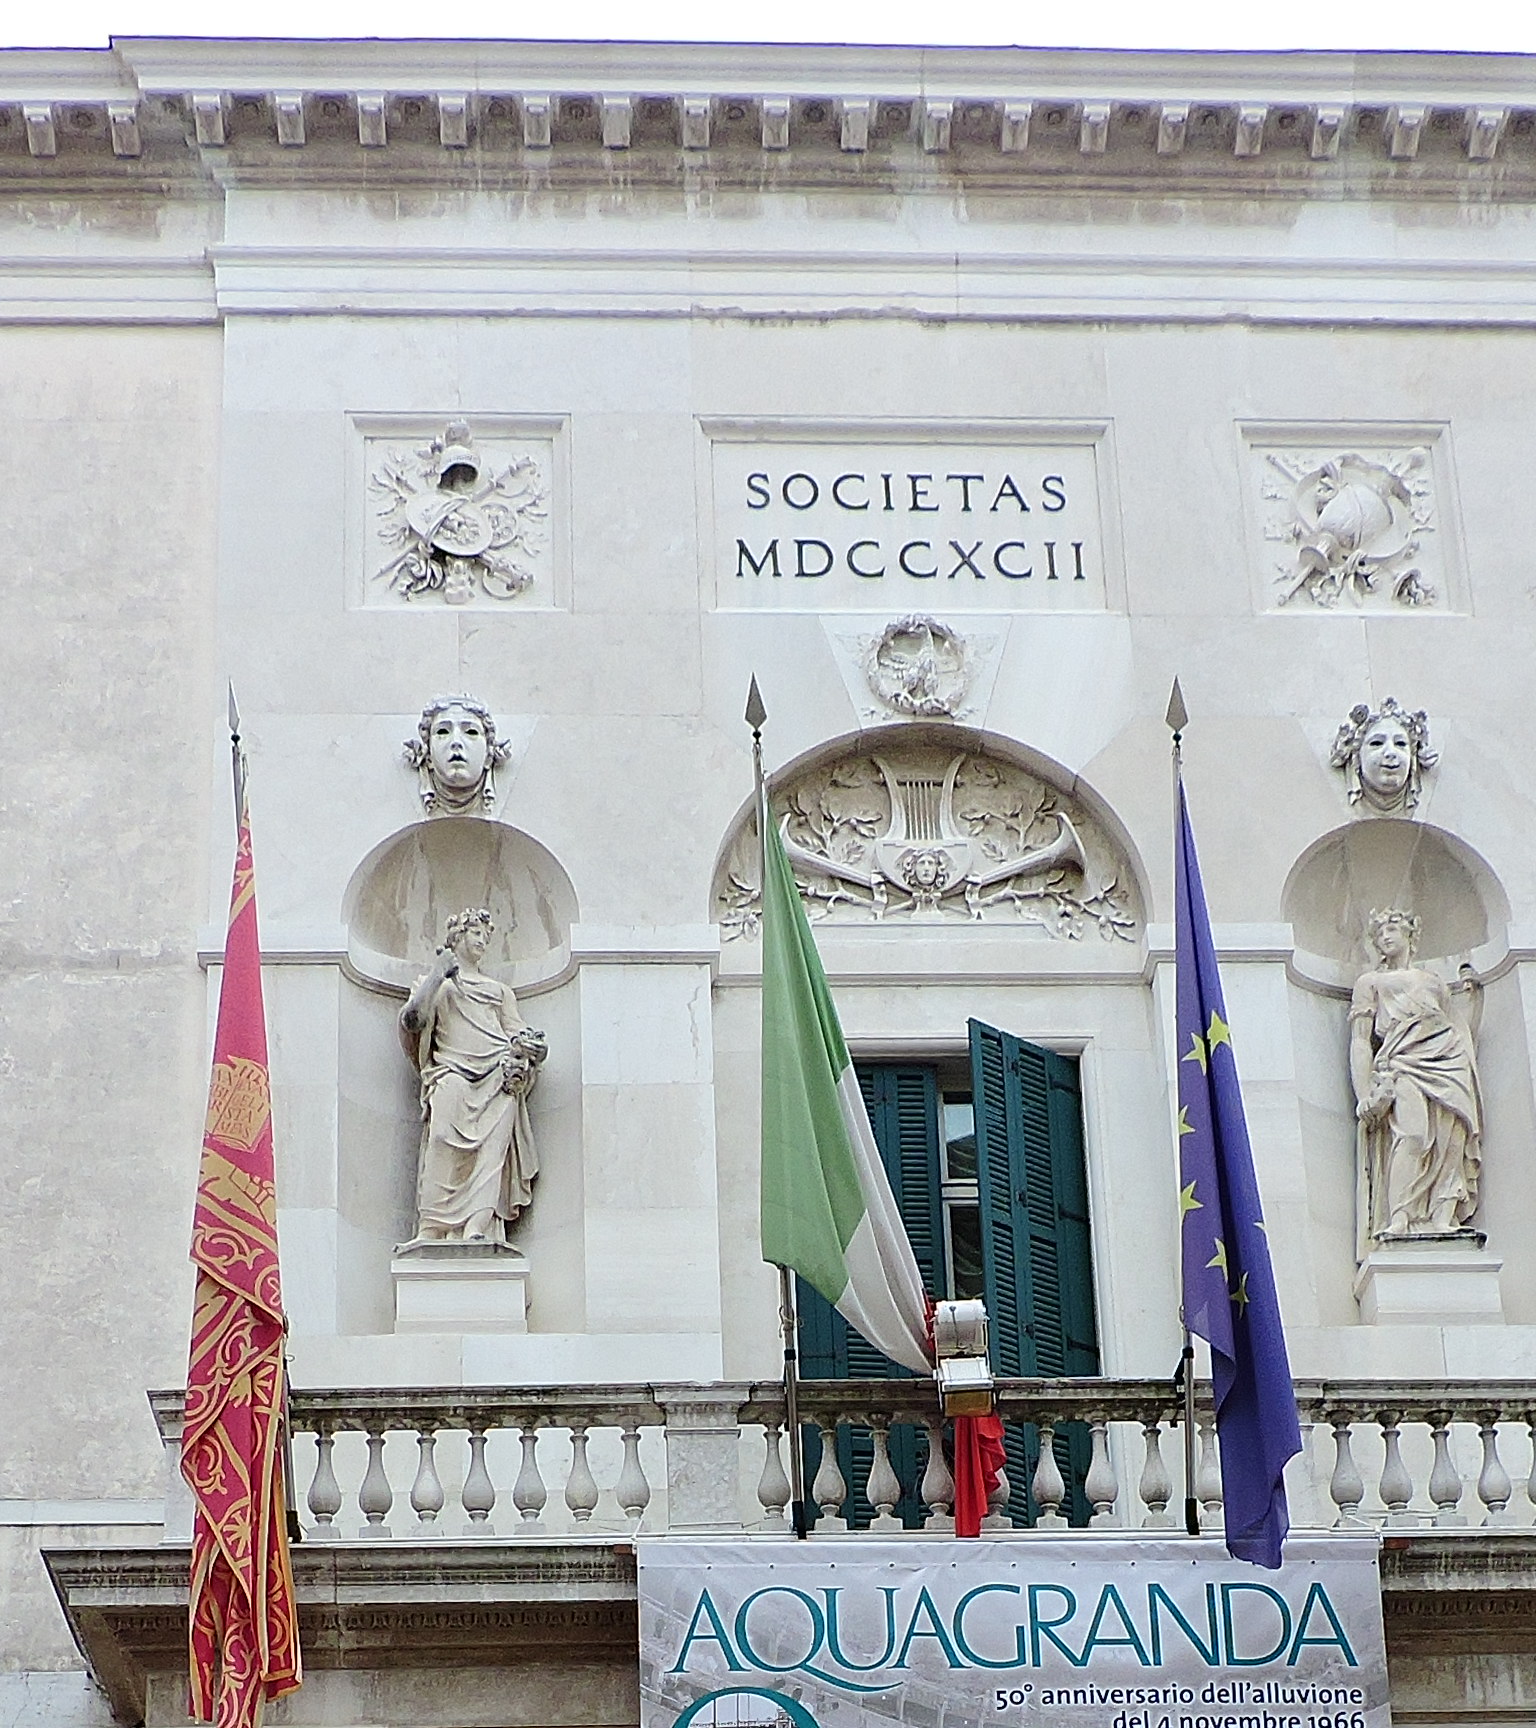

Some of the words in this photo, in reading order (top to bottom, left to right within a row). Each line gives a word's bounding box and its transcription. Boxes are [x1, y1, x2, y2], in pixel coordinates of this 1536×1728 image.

[746, 472, 1067, 513] SOCIETAS
[735, 538, 1086, 580] MDCCXCII
[665, 1582, 1360, 1693] AQUAGRANDA
[995, 1684, 1034, 1711] 50°
[1041, 1683, 1194, 1706] anniversario
[1201, 1681, 1364, 1706] dell’alluvione
